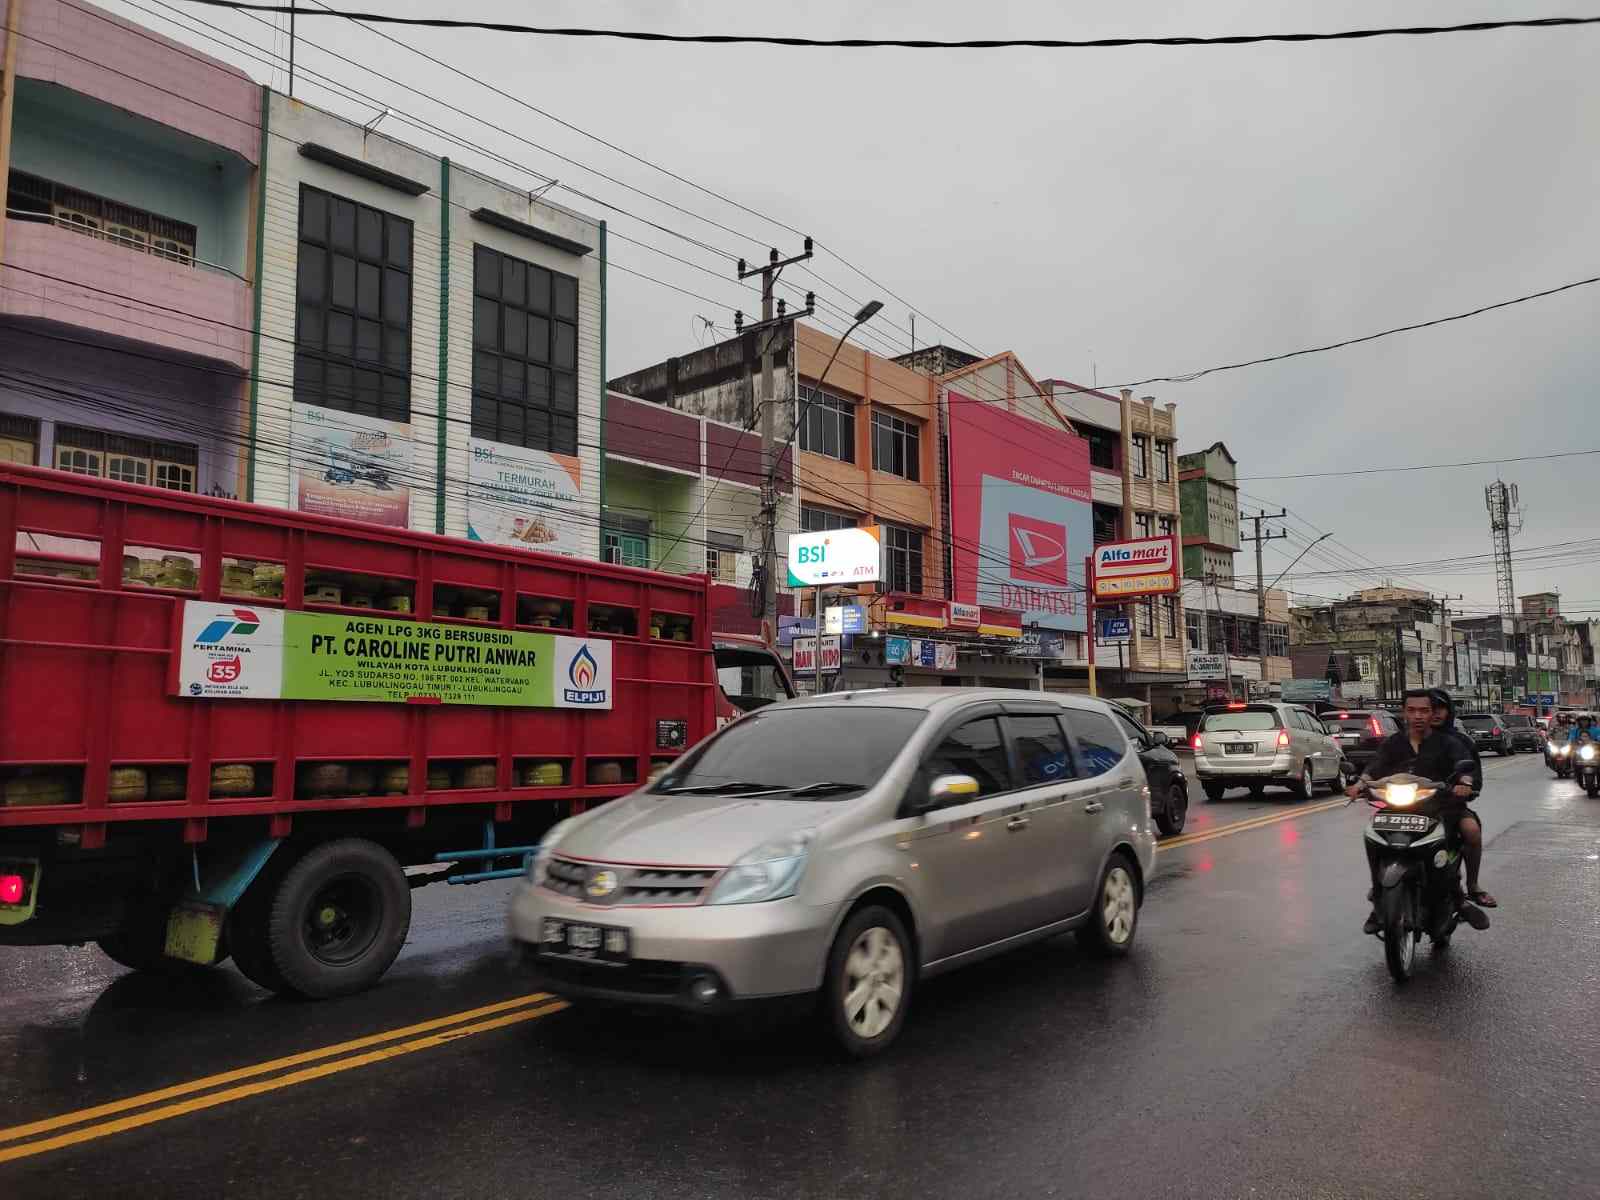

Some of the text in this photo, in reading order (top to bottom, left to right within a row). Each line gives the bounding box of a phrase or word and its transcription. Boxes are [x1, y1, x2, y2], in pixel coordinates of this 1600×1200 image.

[474, 447, 495, 460] BSI
[498, 471, 556, 490] TERMURAH
[798, 545, 826, 564] BSI
[853, 565, 874, 576] ATM
[1001, 583, 1077, 616] DAIHATSU
[346, 621, 513, 645] AGEN LPG 3KG BERSUBSIDI
[193, 644, 252, 653] PERTAMINA
[311, 634, 536, 667] PT. CAROLINE PUTRI ANWAR
[336, 669, 355, 678] YOS
[357, 670, 401, 680] SUDARSO
[358, 660, 501, 675] WILAYAH KOTA LUBUKLINGGAU
[353, 680, 424, 690] LUBUKLINGGAU
[463, 685, 523, 694] LUBUKLINGGAU
[566, 691, 604, 702] ELPIJI
